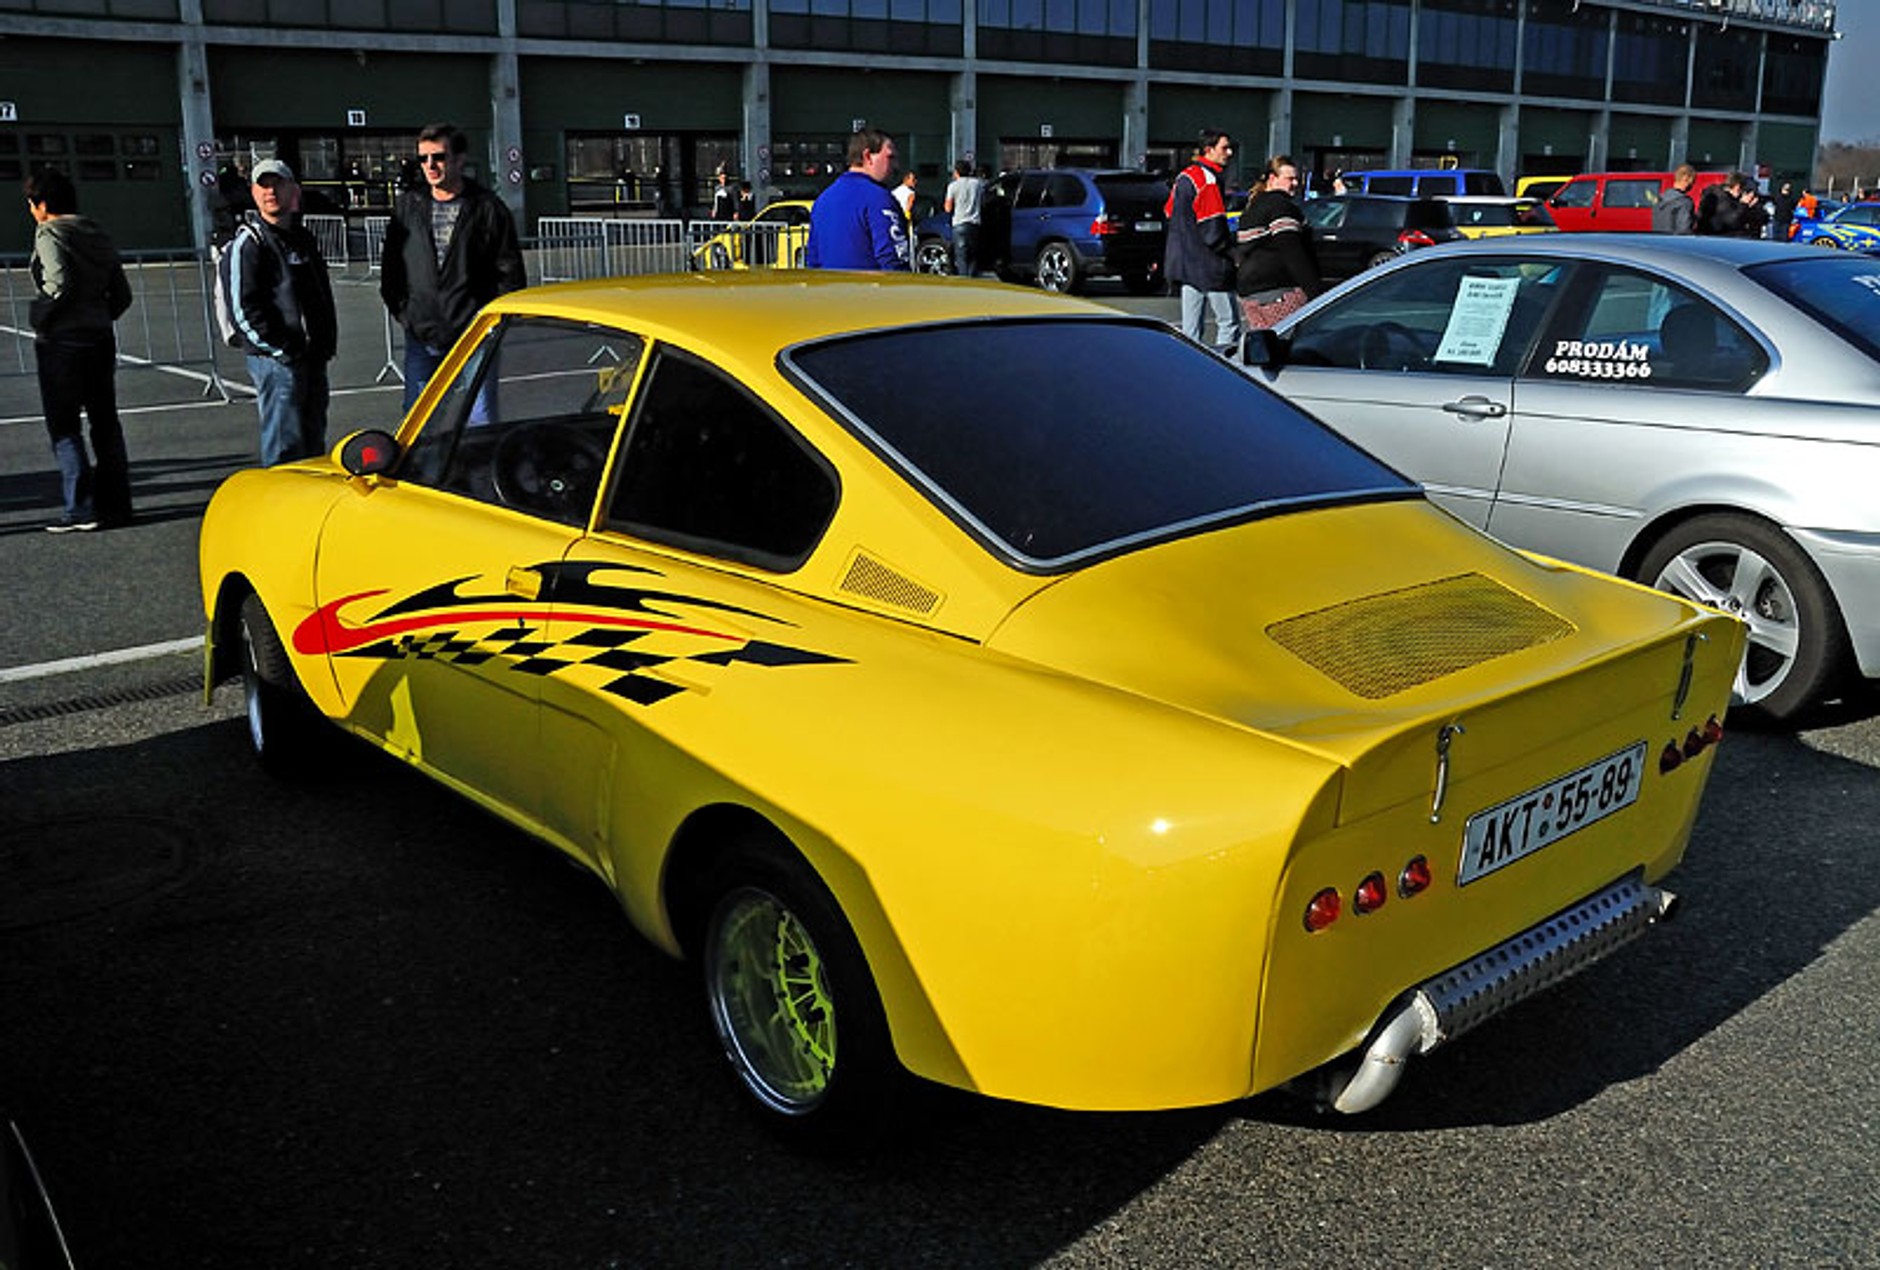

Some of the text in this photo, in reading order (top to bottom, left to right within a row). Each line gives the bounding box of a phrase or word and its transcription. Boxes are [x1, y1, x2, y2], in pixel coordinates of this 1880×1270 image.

[1556, 340, 1649, 360] PRODÁM
[1546, 358, 1651, 377] 608333366
[1478, 757, 1633, 869] AKT 55-89
